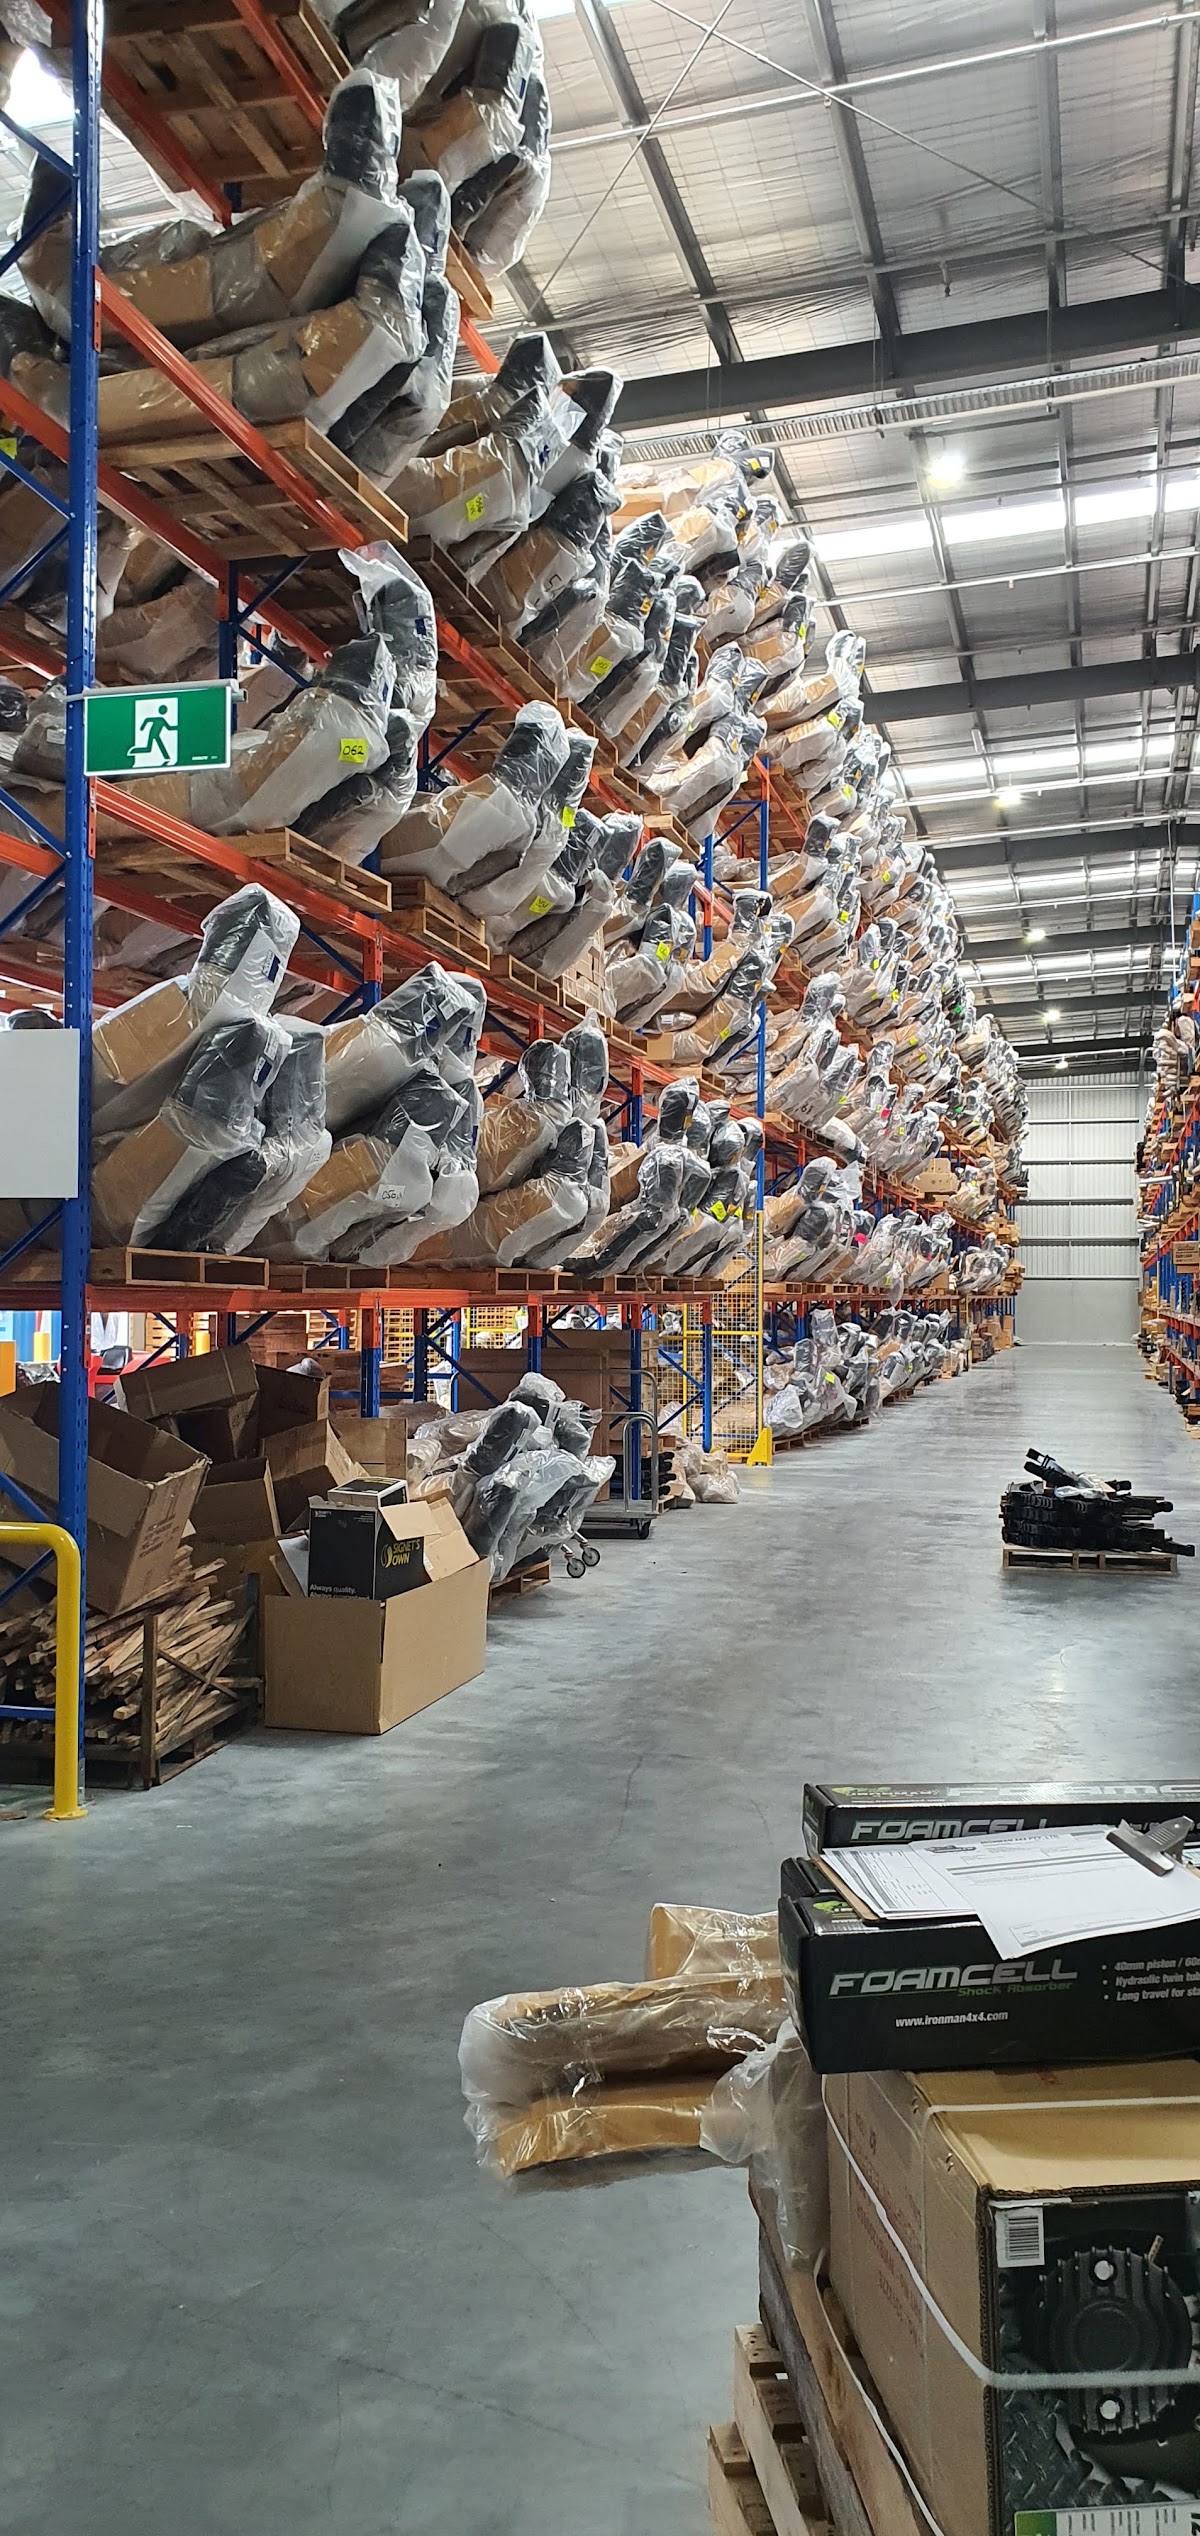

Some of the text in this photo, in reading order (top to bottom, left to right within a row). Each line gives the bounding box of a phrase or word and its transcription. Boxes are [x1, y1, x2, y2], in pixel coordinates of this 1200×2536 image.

[342, 745, 365, 756] 062
[391, 1551, 411, 1566] OWN
[310, 1584, 333, 1593] Always
[1114, 1961, 1145, 1971] 40mm
[1146, 1959, 1177, 1971] piston
[828, 1958, 1079, 1996] FOAMCELL
[1115, 1974, 1161, 1988] Hydraulic
[1162, 1973, 1184, 1984] twin
[957, 1981, 1073, 1997] Shock Absorber
[1116, 1991, 1140, 2002] Long
[1141, 1988, 1170, 2000] travel
[1171, 1987, 1186, 1998] for
[895, 2011, 1009, 2028] www.ironman4x4.com
